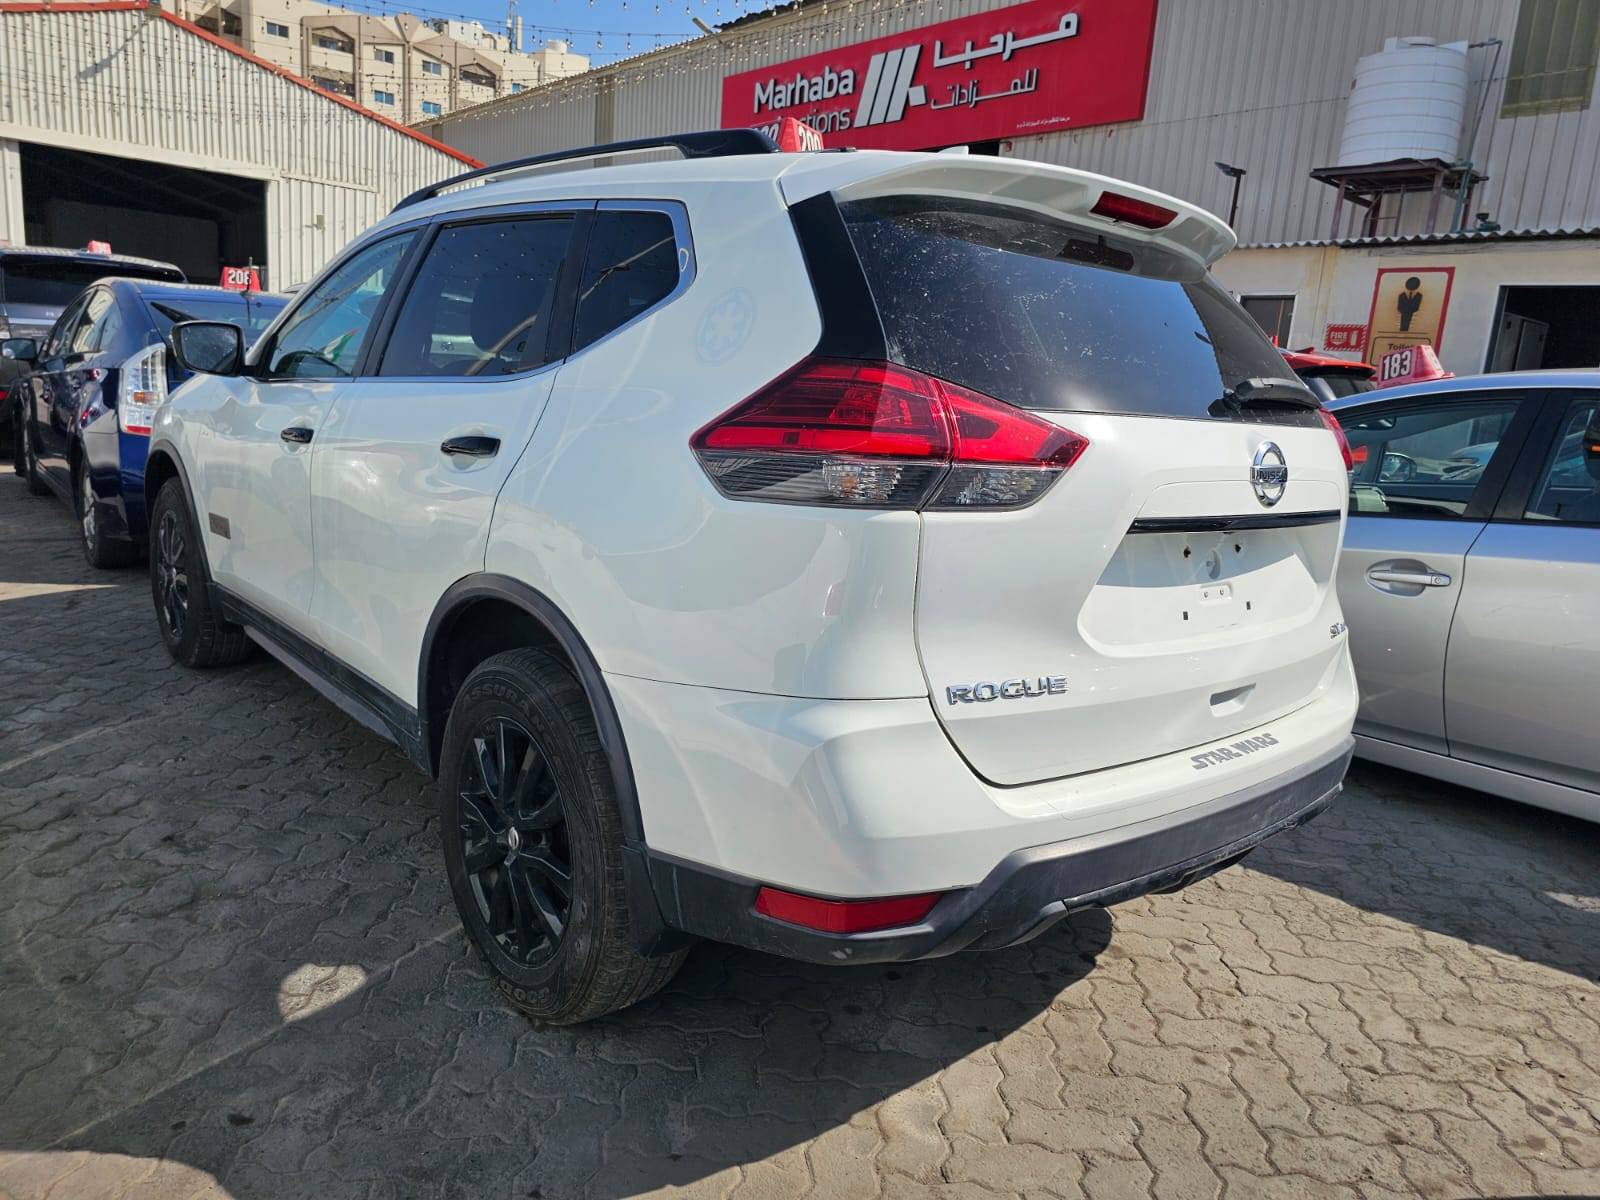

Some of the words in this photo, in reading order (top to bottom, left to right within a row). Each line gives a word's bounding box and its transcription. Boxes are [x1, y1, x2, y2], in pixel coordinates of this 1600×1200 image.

[933, 12, 1079, 70] مرحبا
[754, 65, 855, 114] Marhaba
[930, 68, 1039, 110] للمزادات
[1330, 331, 1348, 340] FIRE
[1383, 350, 1411, 380] 183
[945, 675, 1069, 706] ROGUE
[1230, 732, 1280, 754] WARS
